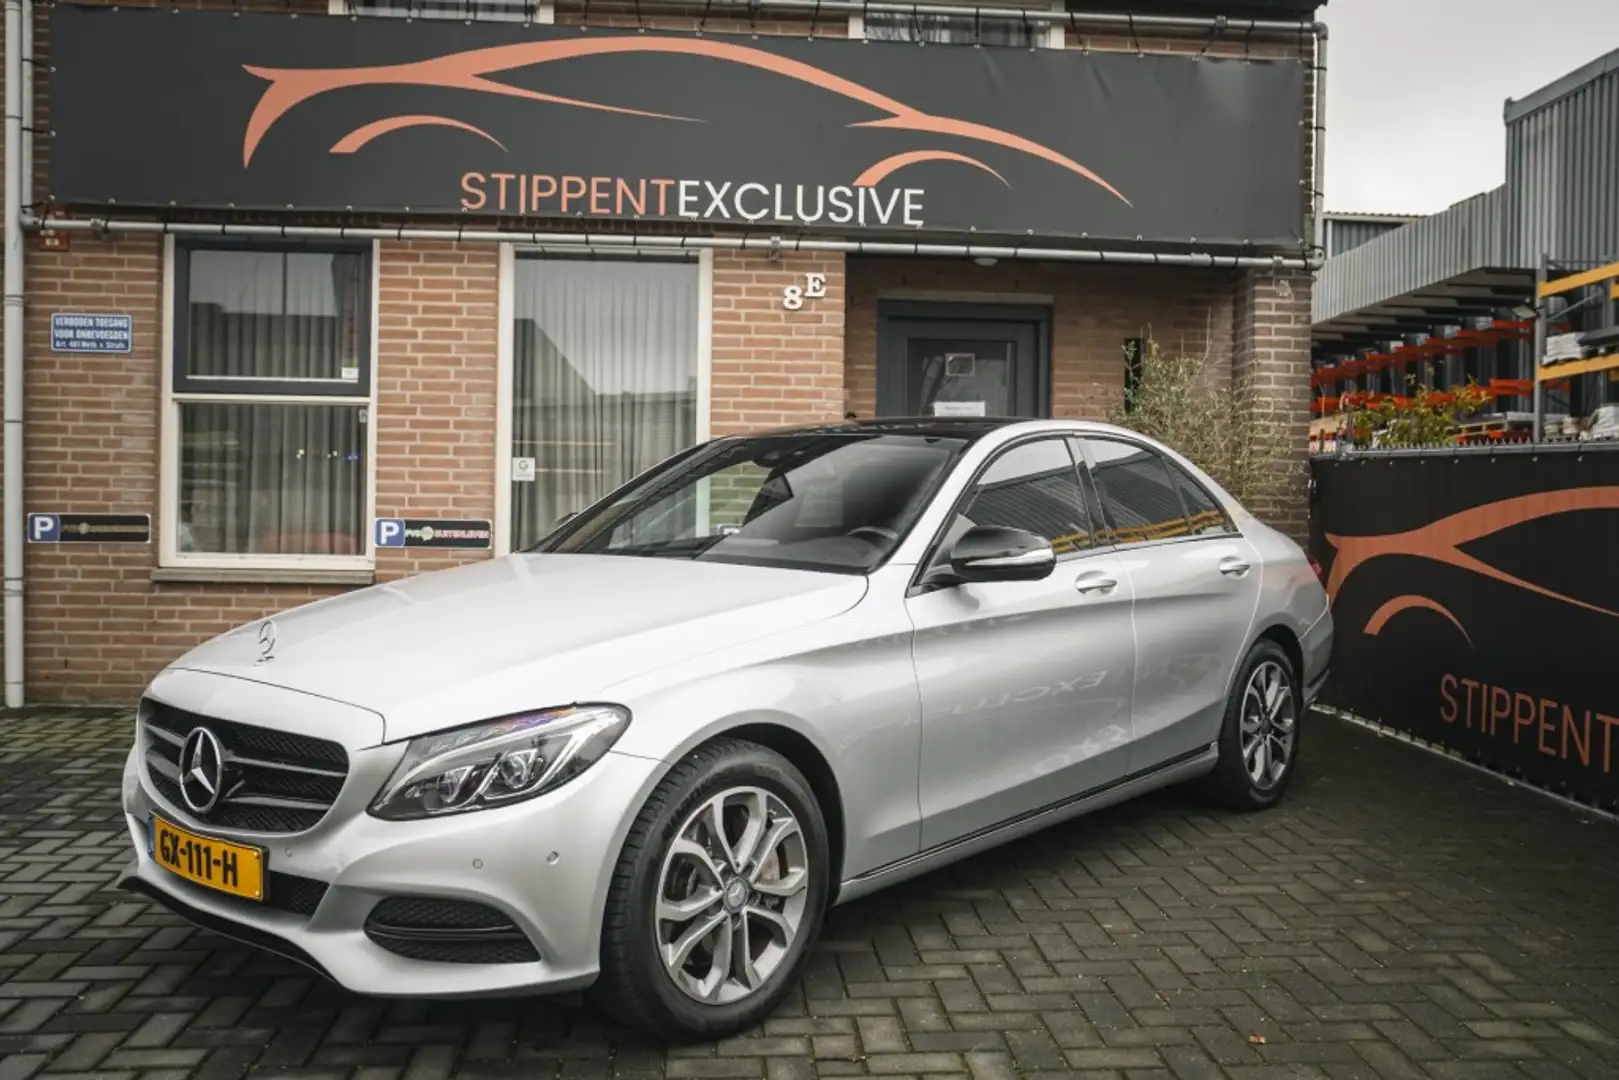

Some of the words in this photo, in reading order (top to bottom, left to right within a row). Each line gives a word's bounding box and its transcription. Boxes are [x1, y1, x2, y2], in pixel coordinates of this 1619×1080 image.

[34, 516, 54, 540] P
[381, 522, 400, 545] P
[160, 829, 238, 888] GX-111-H
